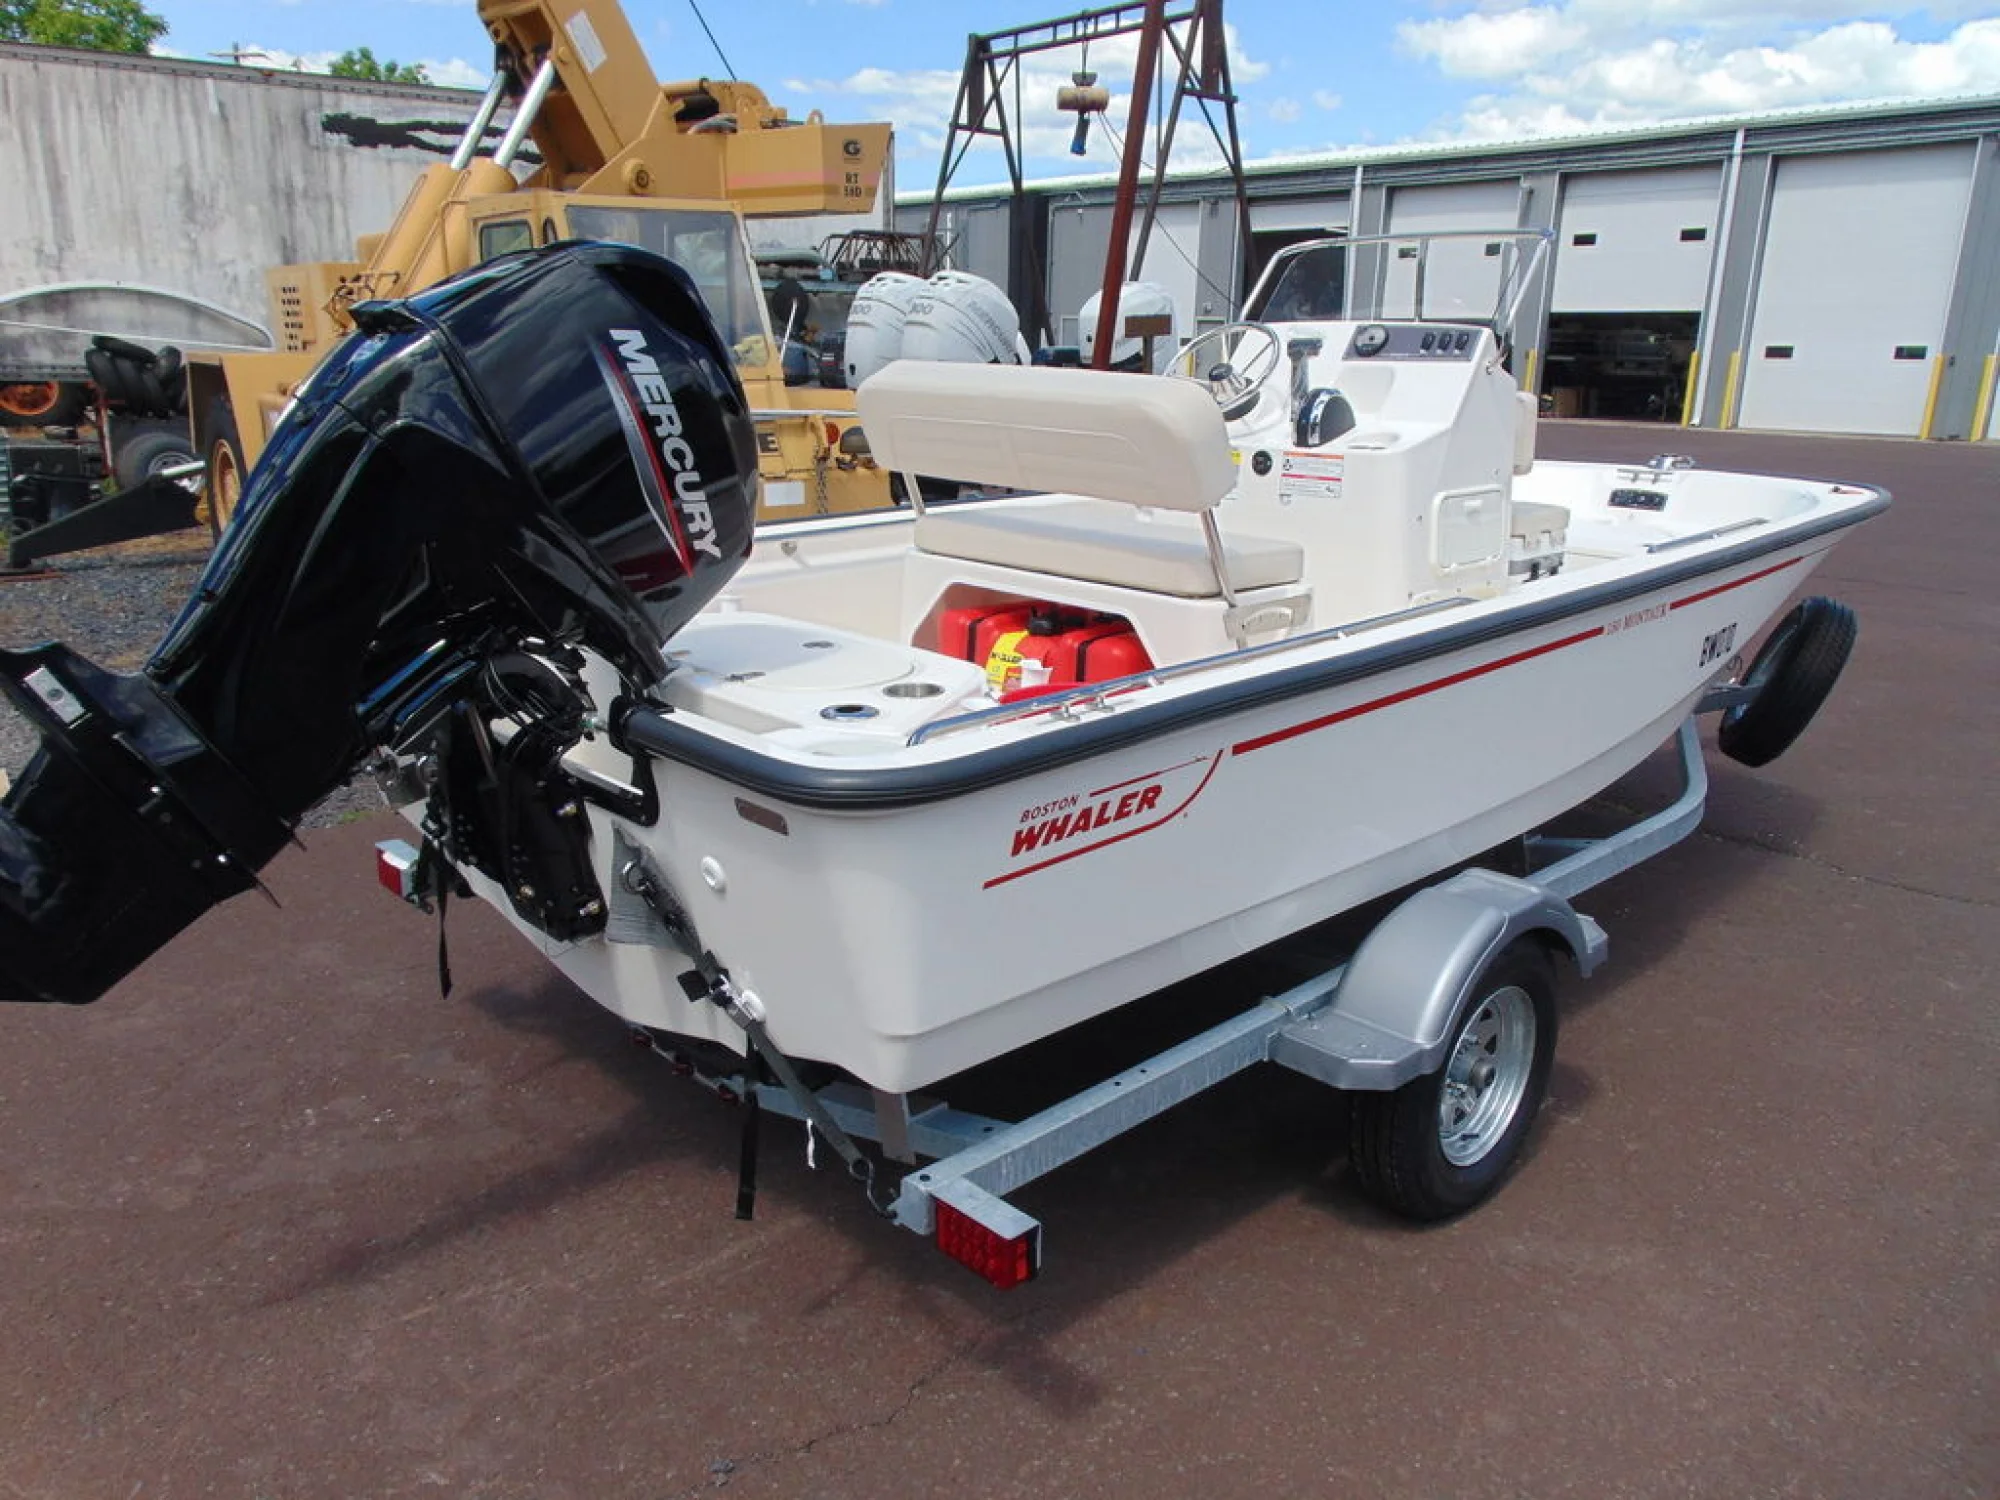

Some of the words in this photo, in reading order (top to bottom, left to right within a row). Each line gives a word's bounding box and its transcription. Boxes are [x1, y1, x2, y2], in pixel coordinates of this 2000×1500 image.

[608, 328, 722, 559] MERCURY
[1011, 784, 1163, 857] WHALER
[1020, 795, 1080, 823] BOSTON
